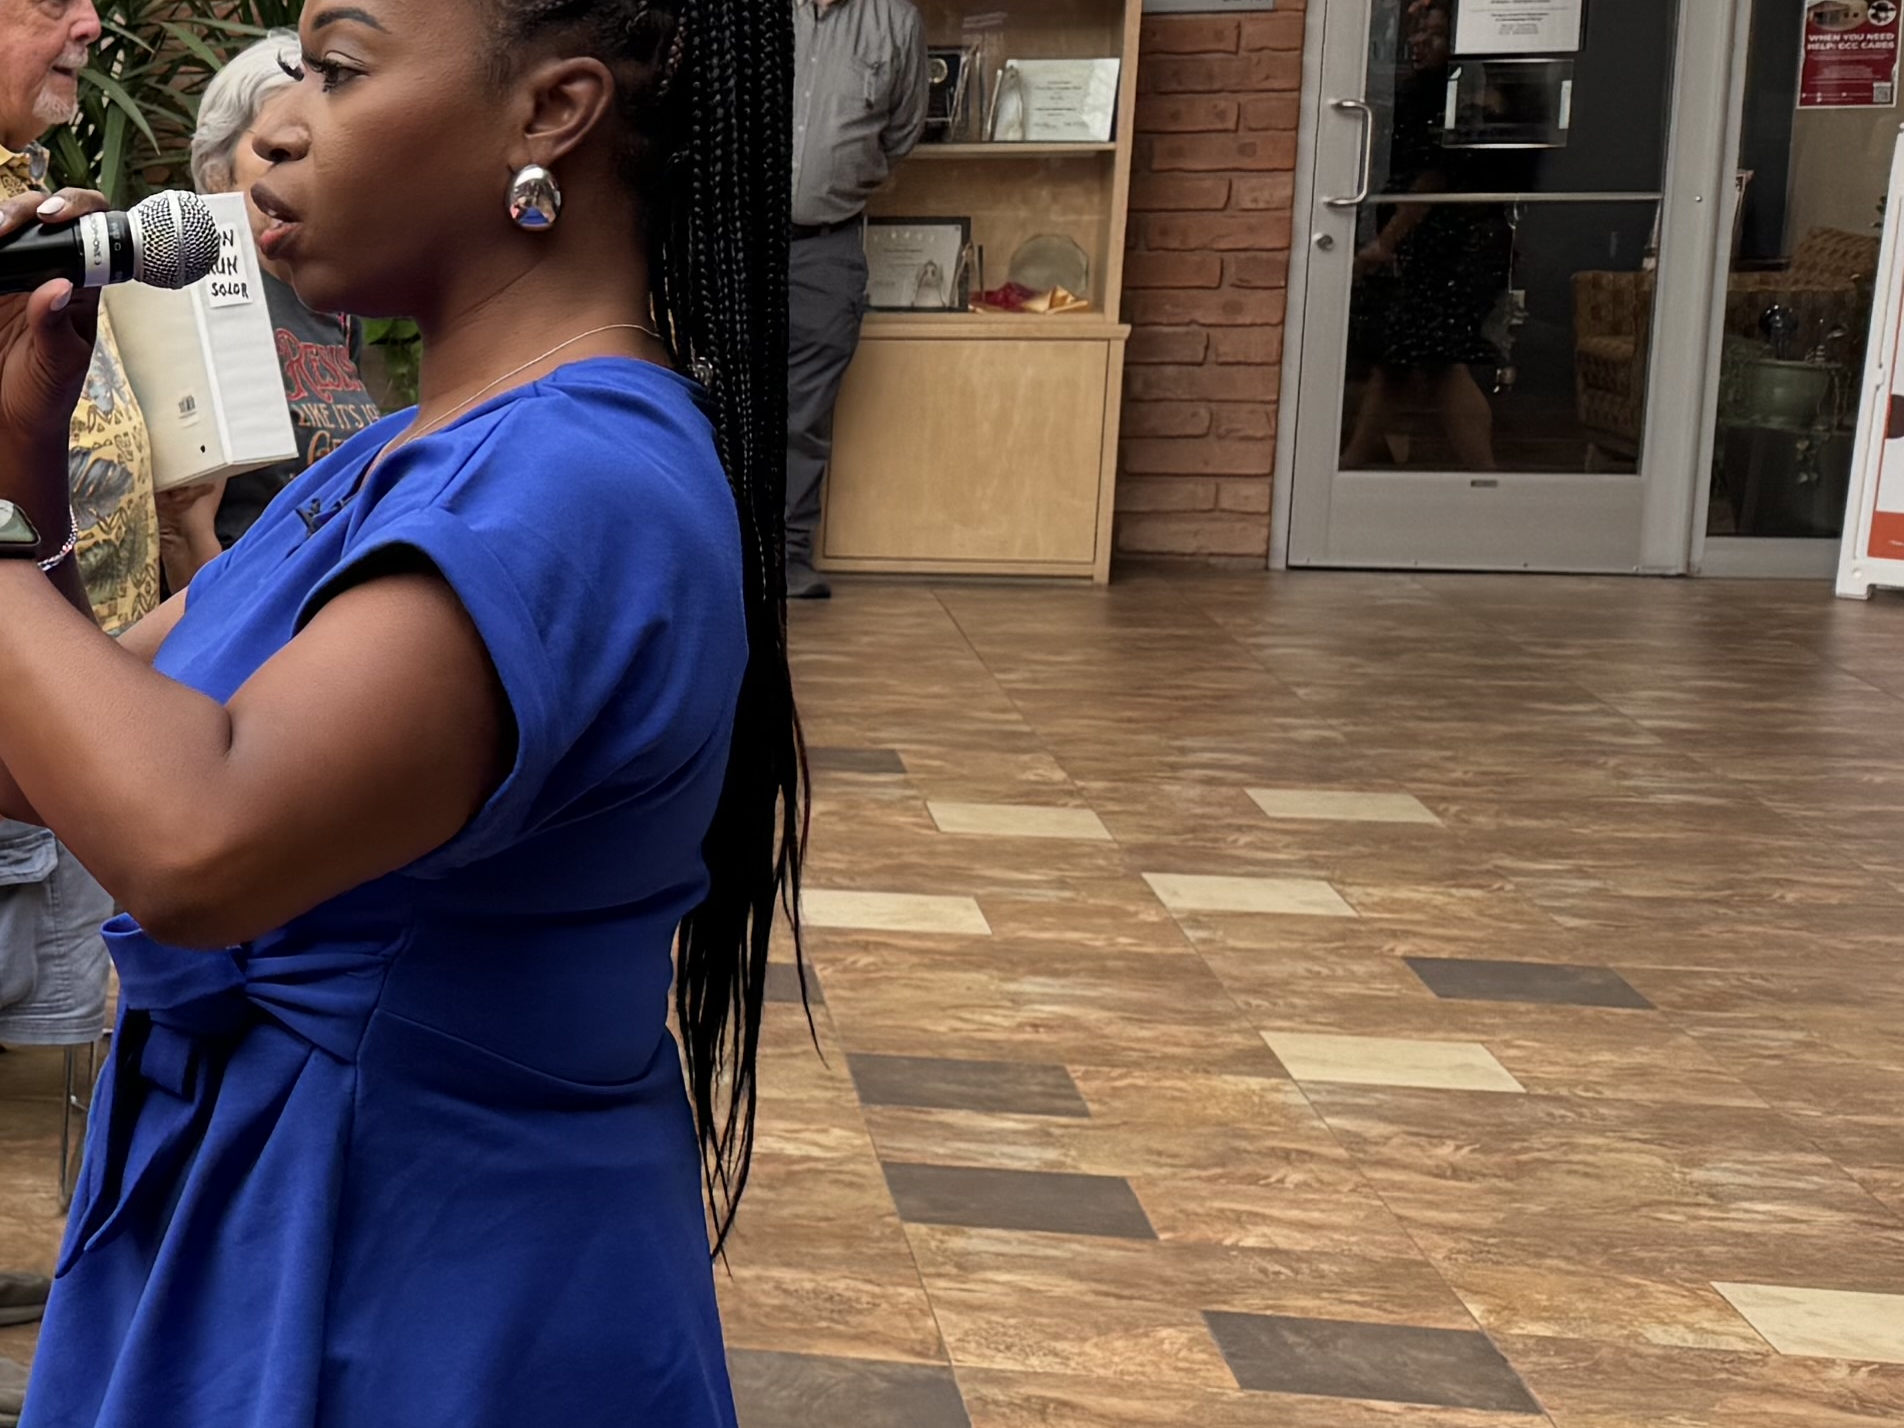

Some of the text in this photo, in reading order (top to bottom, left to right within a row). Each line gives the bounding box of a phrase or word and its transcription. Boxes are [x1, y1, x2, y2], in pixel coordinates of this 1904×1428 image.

[1807, 32, 1895, 42] WHEN YOU NEED
[1860, 41, 1895, 50] CARES
[332, 403, 365, 430] IT'S
